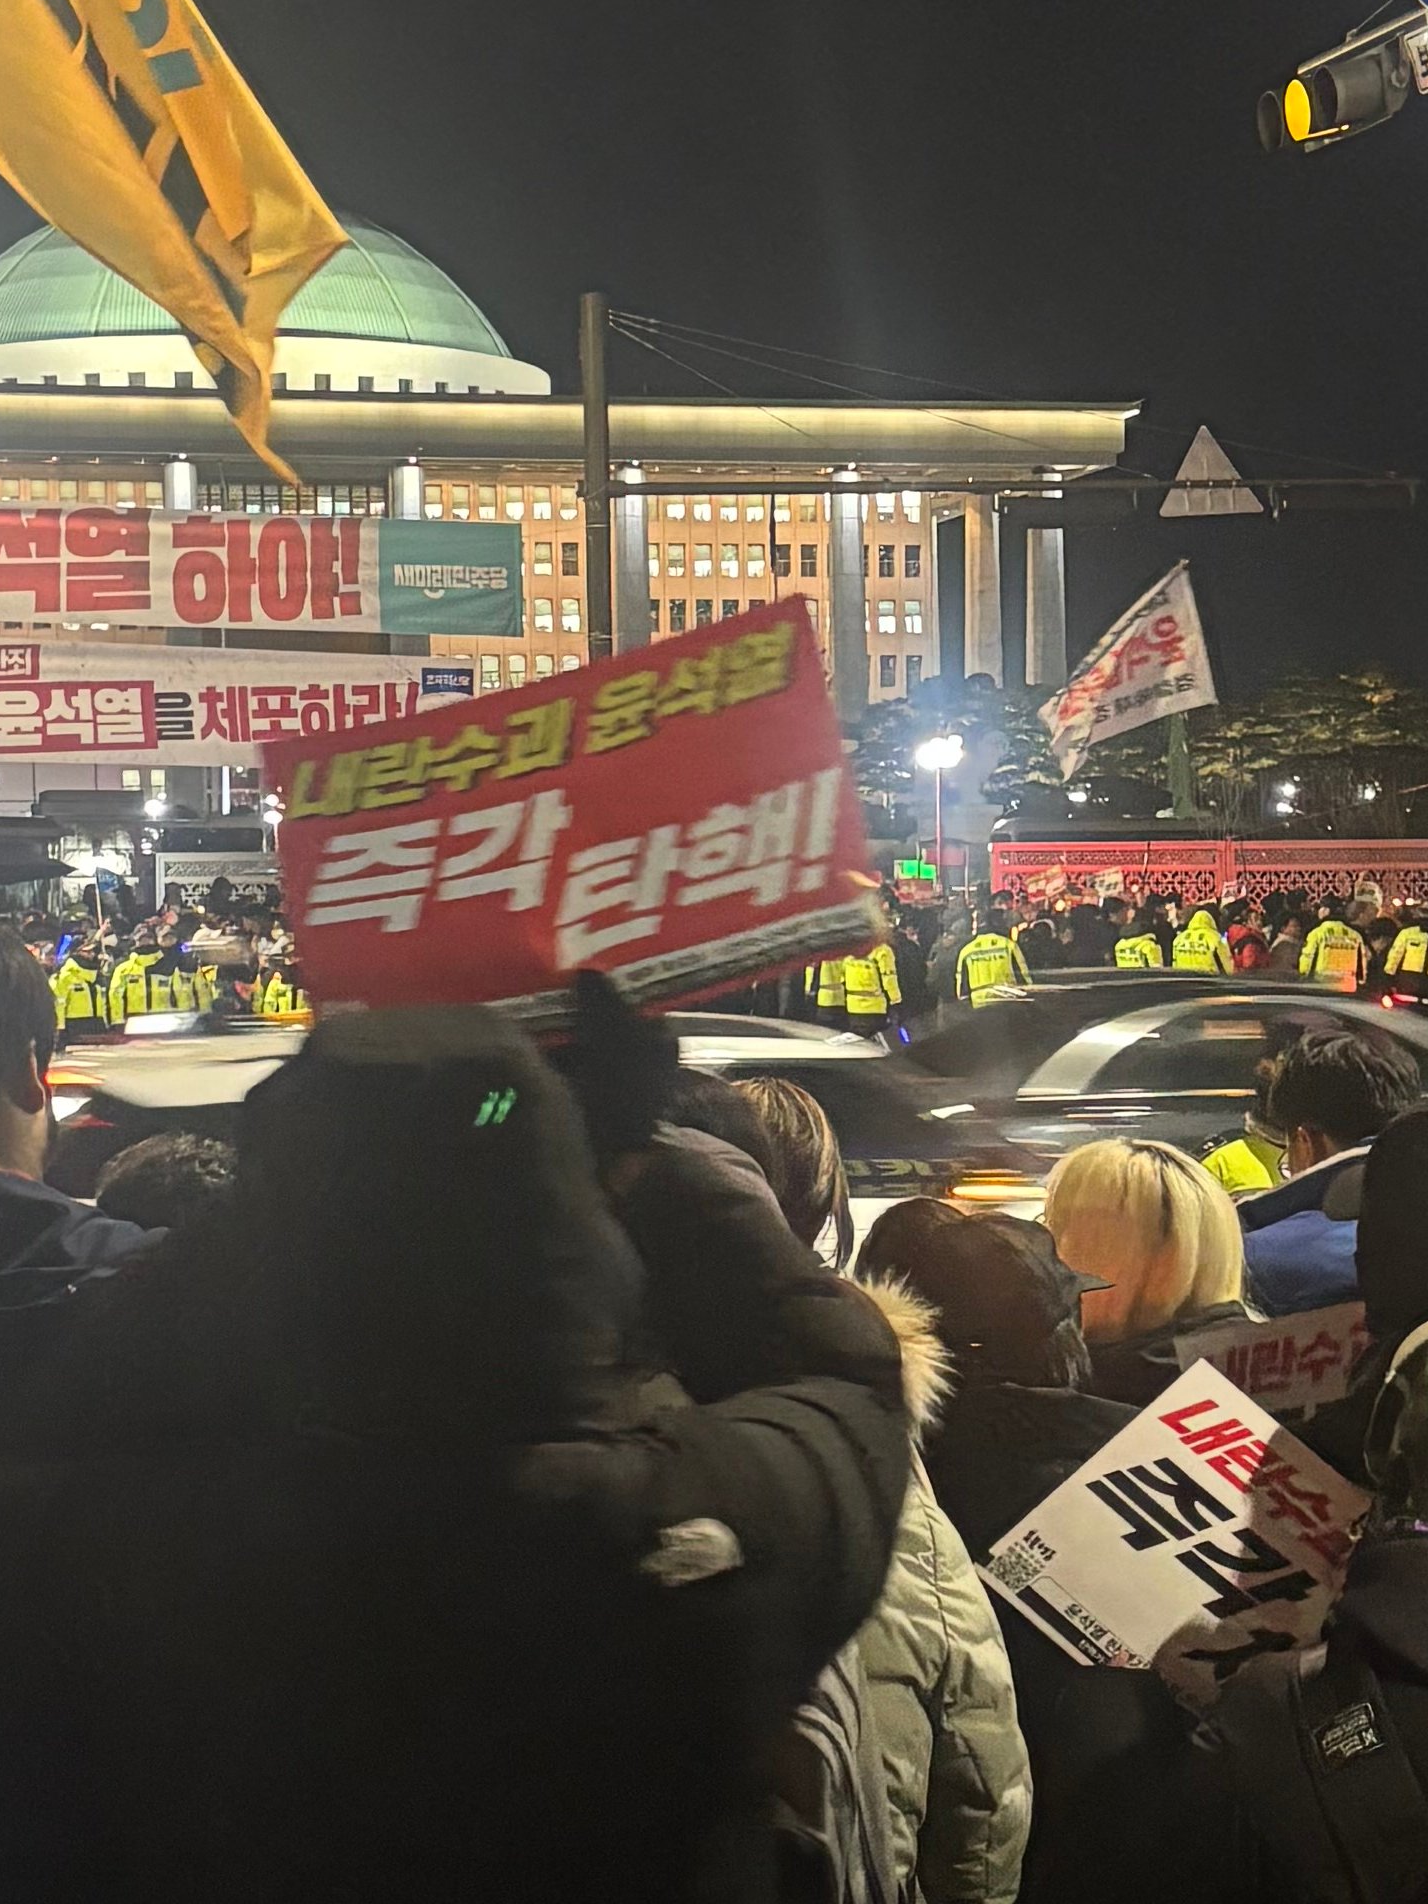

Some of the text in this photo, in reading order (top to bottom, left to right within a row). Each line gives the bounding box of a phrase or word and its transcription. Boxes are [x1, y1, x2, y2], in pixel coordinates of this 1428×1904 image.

[172, 515, 362, 623] 하야!
[393, 563, 508, 590] 새미래민주당
[287, 621, 800, 819] 내란수괴 윤석열
[307, 788, 573, 932] 즉각
[553, 766, 844, 971] 탄핵!
[1085, 1457, 1322, 1621] 즉각
